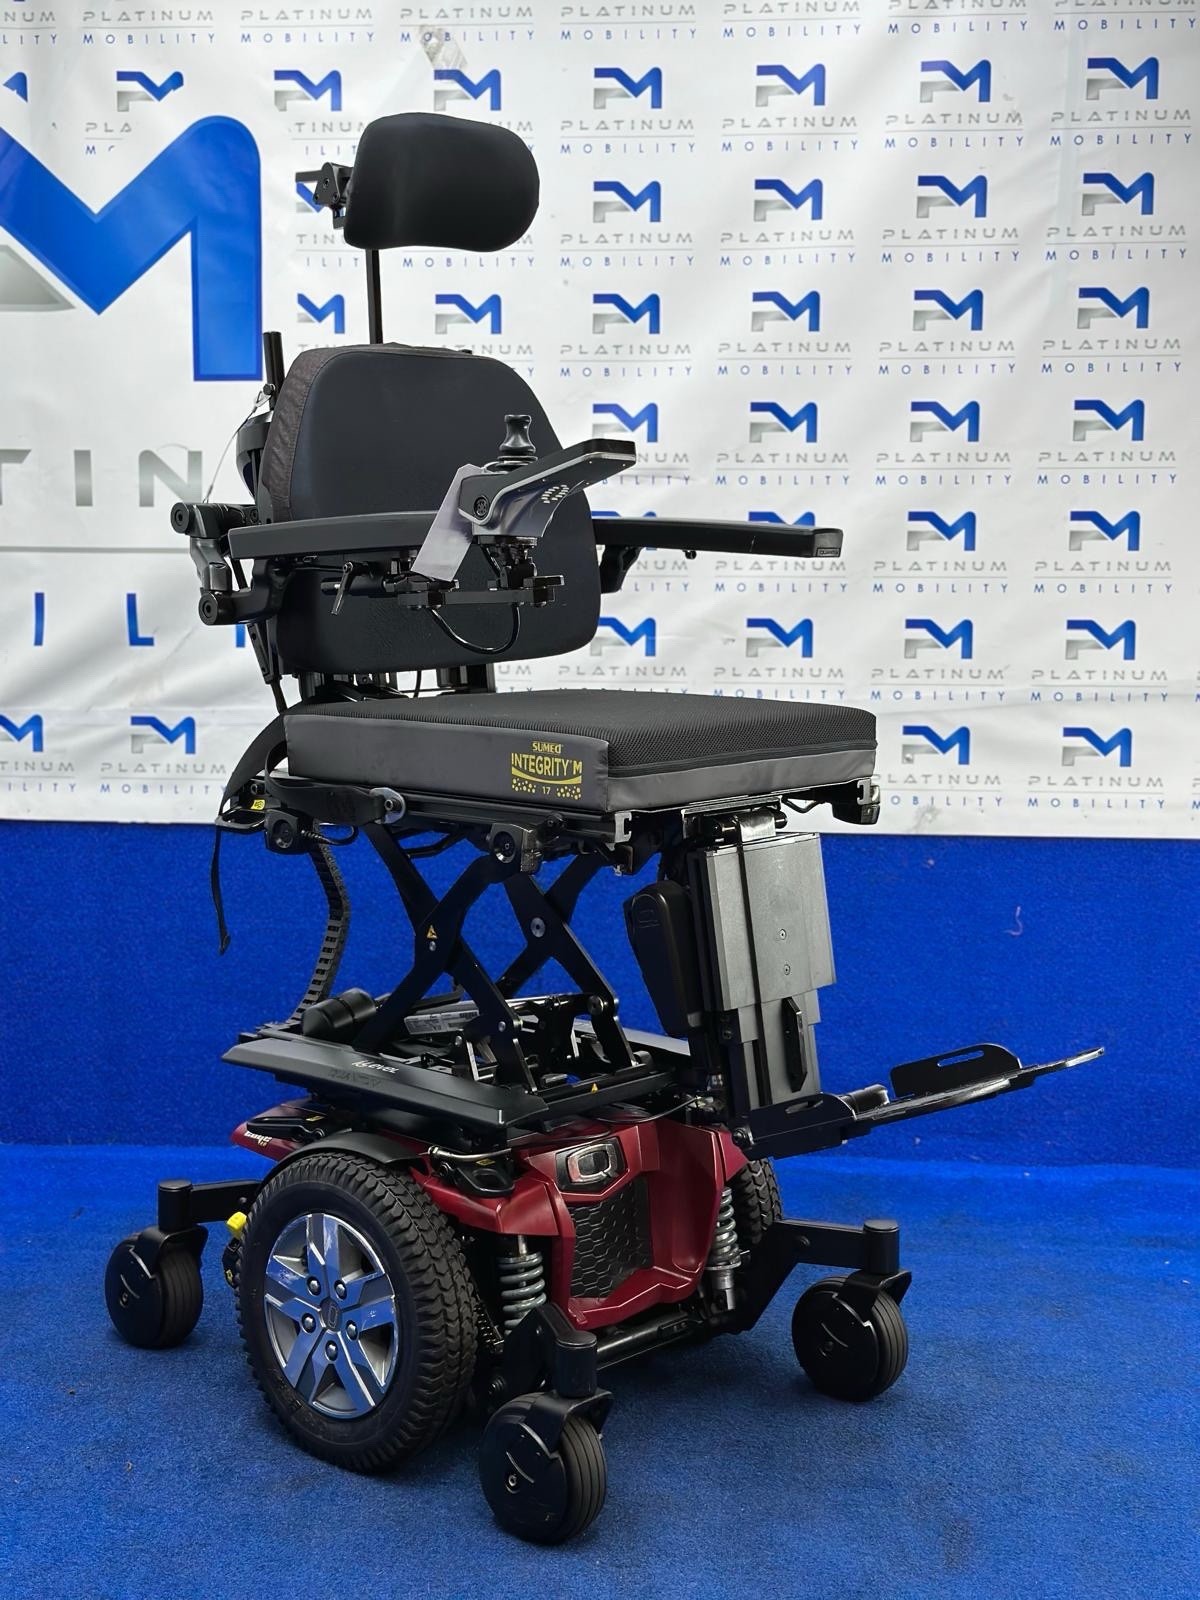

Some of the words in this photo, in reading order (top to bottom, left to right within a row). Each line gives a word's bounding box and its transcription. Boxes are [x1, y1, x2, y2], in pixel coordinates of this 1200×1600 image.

[400, 6, 532, 19] PLATINUM
[561, 5, 695, 16] PLATINUM
[724, 1, 859, 14] PLATINUM
[83, 10, 213, 21] PLATINUM
[241, 8, 372, 20] PLATINUM
[888, 21, 1027, 34] MOBILITY
[1054, 18, 1195, 30] MOBILITY
[401, 29, 533, 44] MOBILITY
[561, 29, 696, 40] MOBILITY
[723, 25, 860, 37] MOBILITY
[3, 34, 57, 45] LITY
[83, 34, 214, 44] MOBILITY
[241, 32, 374, 43] MOBILITY
[921, 60, 991, 102] PM
[1087, 57, 1159, 99] PM
[274, 70, 341, 111] PM
[434, 69, 501, 111] PM
[594, 67, 662, 109] PM
[757, 64, 825, 106] PM
[886, 111, 1022, 125] PLATINUM
[1051, 109, 1190, 122] PLATINUM
[561, 119, 693, 130] PLATINUM
[722, 116, 857, 128] PLATINUM
[722, 140, 858, 151] MOBILITY
[885, 137, 1023, 148] MOBILITY
[1050, 134, 1191, 146] MOBILITY
[561, 143, 694, 154] MOBILITY
[918, 175, 987, 218] PM
[1083, 172, 1154, 215] PM
[594, 181, 661, 222] PM
[755, 179, 823, 220] PM
[721, 230, 854, 243] PLATINUM
[883, 228, 1019, 239] PLATINUM
[1047, 225, 1185, 237] PLATINUM
[561, 233, 692, 244] PLATINUM
[720, 253, 855, 266] MOBILITY
[881, 251, 1019, 263] MOBILITY
[1046, 249, 1186, 260] MOBILITY
[403, 257, 534, 267] MOBILITY
[560, 256, 694, 269] MOBILITY
[753, 291, 820, 332] PM
[914, 289, 983, 330] PM
[1079, 287, 1149, 328] PM
[435, 294, 501, 334] PM
[593, 294, 660, 334] PM
[560, 344, 691, 355] PLATINUM
[719, 342, 851, 352] PLATINUM
[880, 341, 1014, 352] PLATINUM
[1043, 339, 1180, 350] PLATINUM
[560, 367, 691, 377] MOBILITY
[718, 365, 852, 375] MOBILITY
[879, 364, 1015, 375] MOBILITY
[1041, 362, 1181, 373] MOBILITY
[751, 402, 817, 442] PM
[911, 401, 980, 442] PM
[1074, 400, 1144, 441] PM
[717, 453, 848, 463] PLATINUM
[876, 452, 1010, 463] PLATINUM
[1039, 451, 1175, 462] PLATINUM
[716, 475, 849, 485] MOBILITY
[876, 475, 1011, 485] MOBILITY
[1037, 474, 1176, 484] MOBILITY
[908, 511, 976, 551] PM
[1070, 511, 1140, 551] PM
[716, 561, 846, 571] PLATINUM
[874, 561, 1007, 571] PLATINUM
[1035, 561, 1171, 571] PLATINUM
[715, 583, 847, 592] MOBILITY
[873, 583, 1007, 593] MOBILITY
[1034, 584, 1172, 593] MOBILITY
[747, 618, 813, 657] PM
[906, 619, 973, 659] PM
[1067, 620, 1136, 660] PM
[559, 665, 686, 676] PLATINUM
[714, 667, 844, 678] PLATINUM
[872, 668, 1006, 679] PLATINUM
[1032, 670, 1167, 681] PLATINUM
[871, 690, 1005, 701] MOBILITY
[1031, 692, 1168, 702] MOBILITY
[131, 716, 195, 754] PM
[903, 726, 970, 765] PM
[1063, 727, 1132, 767] PM
[0, 762, 75, 772] TINUM
[101, 763, 226, 774] PLATINUM
[511, 752, 569, 777] INTEGRITY
[572, 761, 583, 775] M
[1028, 776, 1163, 787] PLATINUM
[8, 783, 77, 792] ILITY
[542, 786, 551, 795] 17
[890, 795, 1002, 808] OBILITY
[1028, 798, 1164, 808] MOBILITY
